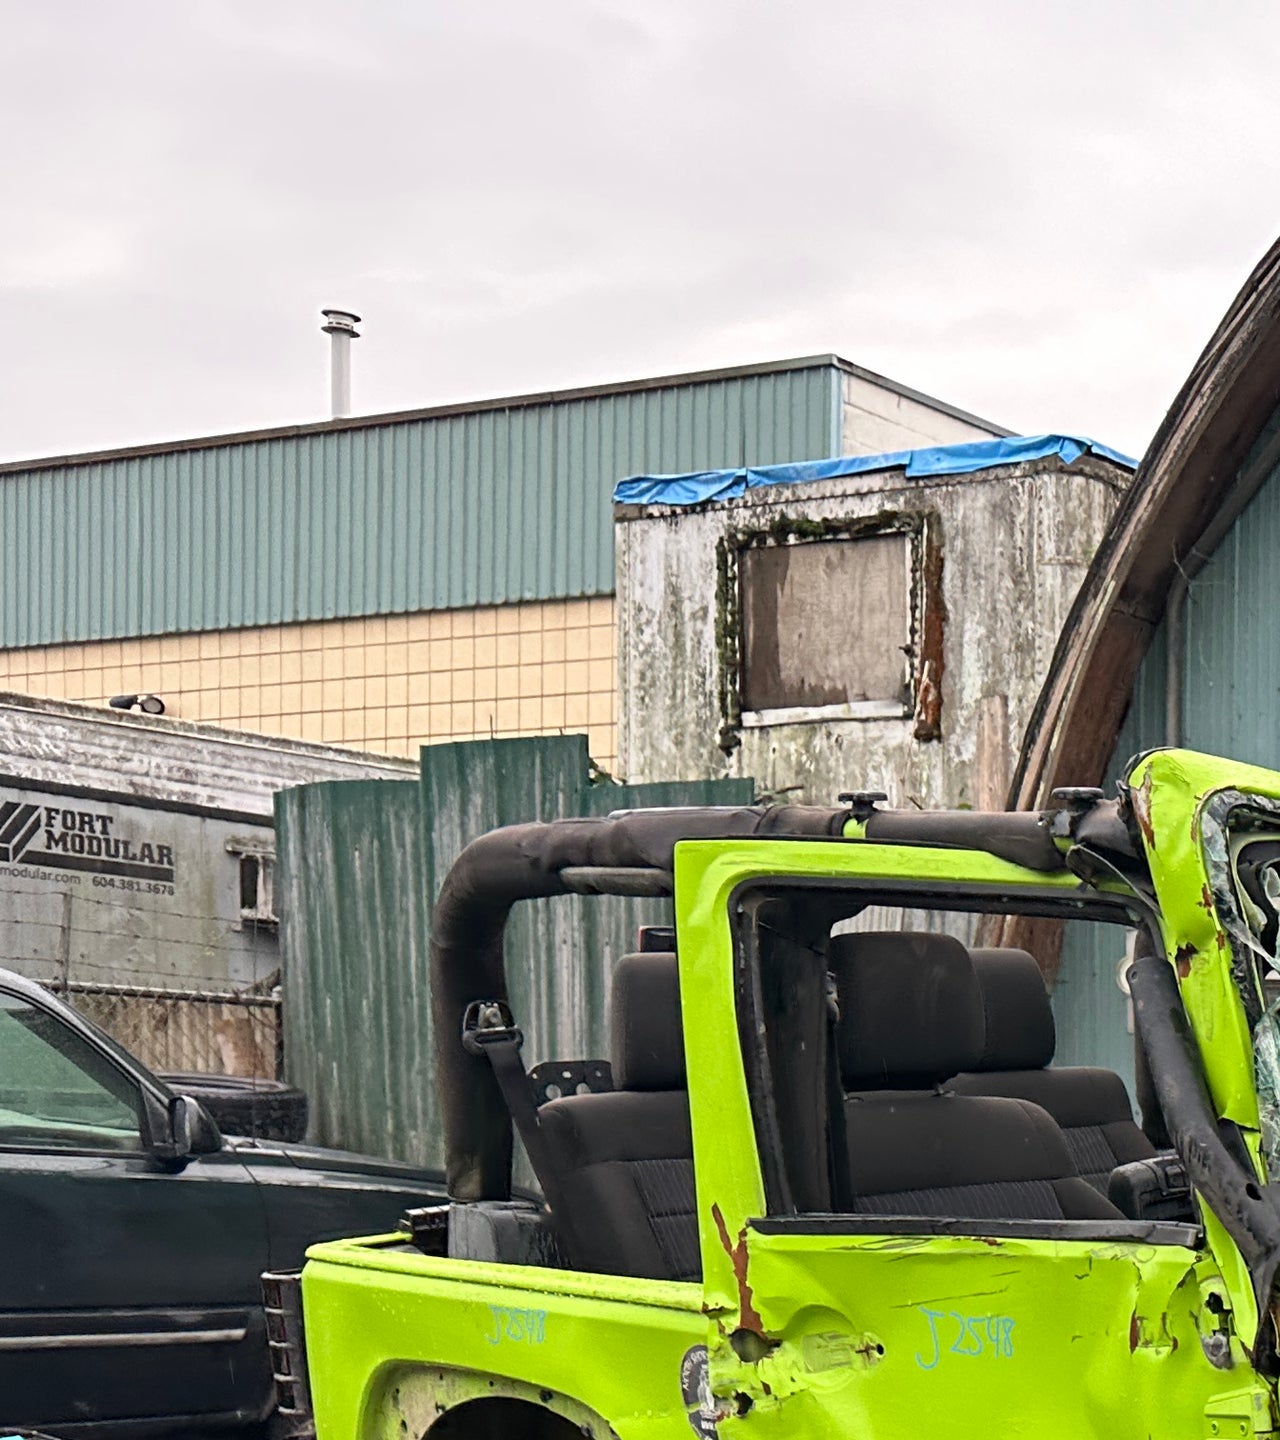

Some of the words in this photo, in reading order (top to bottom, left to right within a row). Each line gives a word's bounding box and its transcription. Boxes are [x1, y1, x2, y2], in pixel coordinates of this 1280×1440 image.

[44, 806, 114, 836] FORT
[45, 829, 174, 867] MODULAR
[915, 1306, 1015, 1370] J2548
